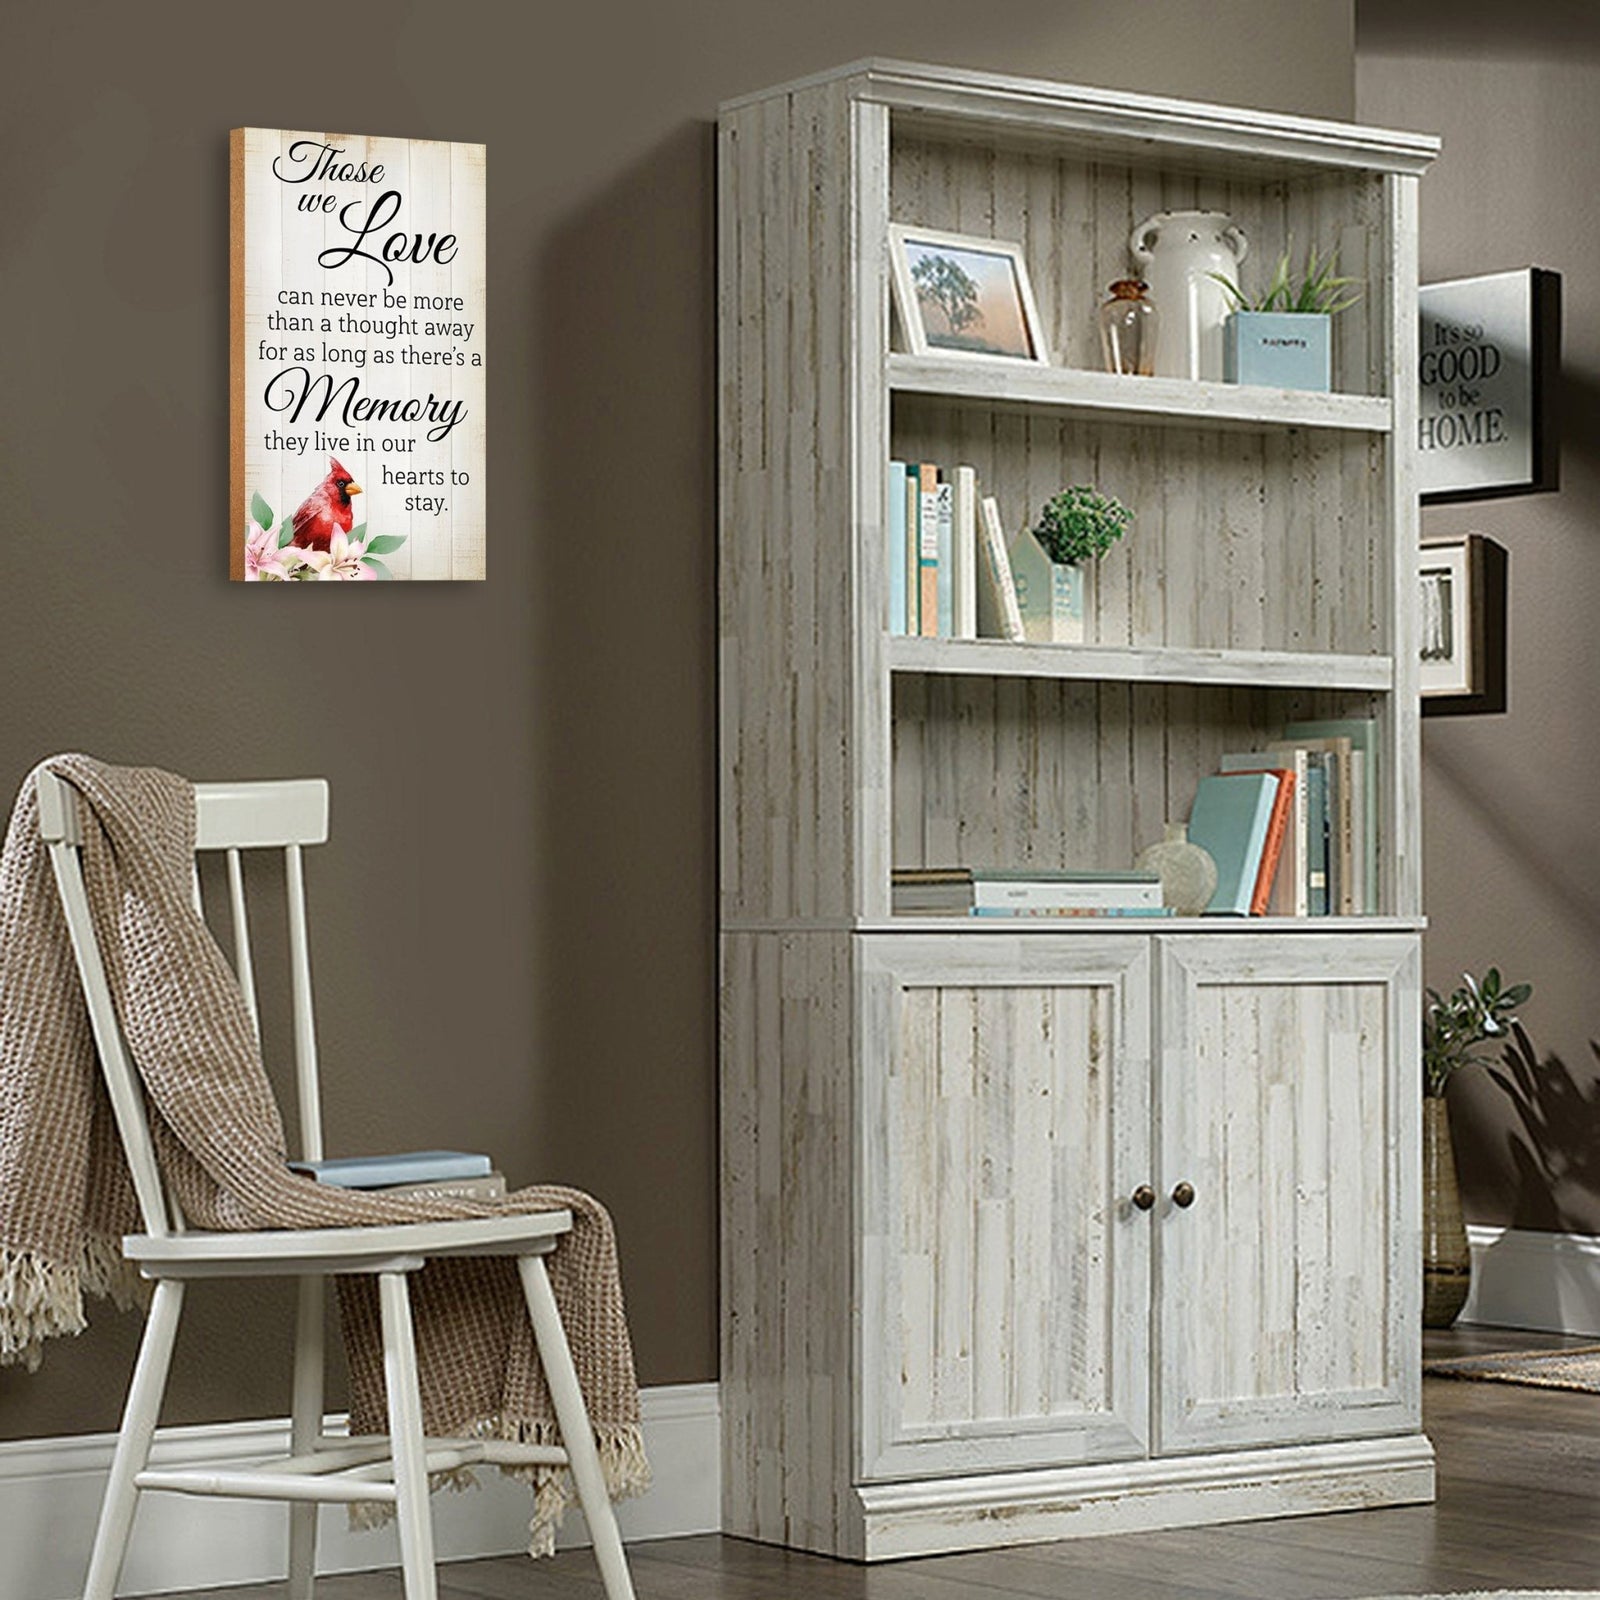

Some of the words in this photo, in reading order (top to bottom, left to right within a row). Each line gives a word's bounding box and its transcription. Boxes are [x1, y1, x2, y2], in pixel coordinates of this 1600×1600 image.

[273, 141, 385, 183] Those
[298, 194, 337, 213] we
[318, 191, 458, 286] Love
[277, 290, 314, 306] can
[320, 292, 378, 308] never
[382, 288, 407, 309] be
[413, 295, 464, 311] more
[267, 310, 314, 332] than
[320, 318, 332, 333] a
[338, 312, 419, 340] thought
[424, 322, 475, 342] away
[1435, 323, 1460, 345] It's
[258, 339, 288, 361] for
[293, 347, 315, 362] as
[321, 341, 367, 369] long
[373, 349, 395, 364] as
[400, 344, 465, 367] there’s
[471, 352, 482, 367] a
[1420, 345, 1500, 385] GOOD
[263, 366, 469, 443] Memory
[1440, 390, 1454, 409] to
[1459, 386, 1480, 405] be
[263, 429, 309, 456] they
[314, 430, 350, 452] live
[356, 432, 376, 452] in
[381, 438, 416, 453] our
[1419, 409, 1508, 450] HOME.
[382, 464, 445, 486] hearts
[450, 469, 470, 486] to
[405, 494, 448, 517] stay.
